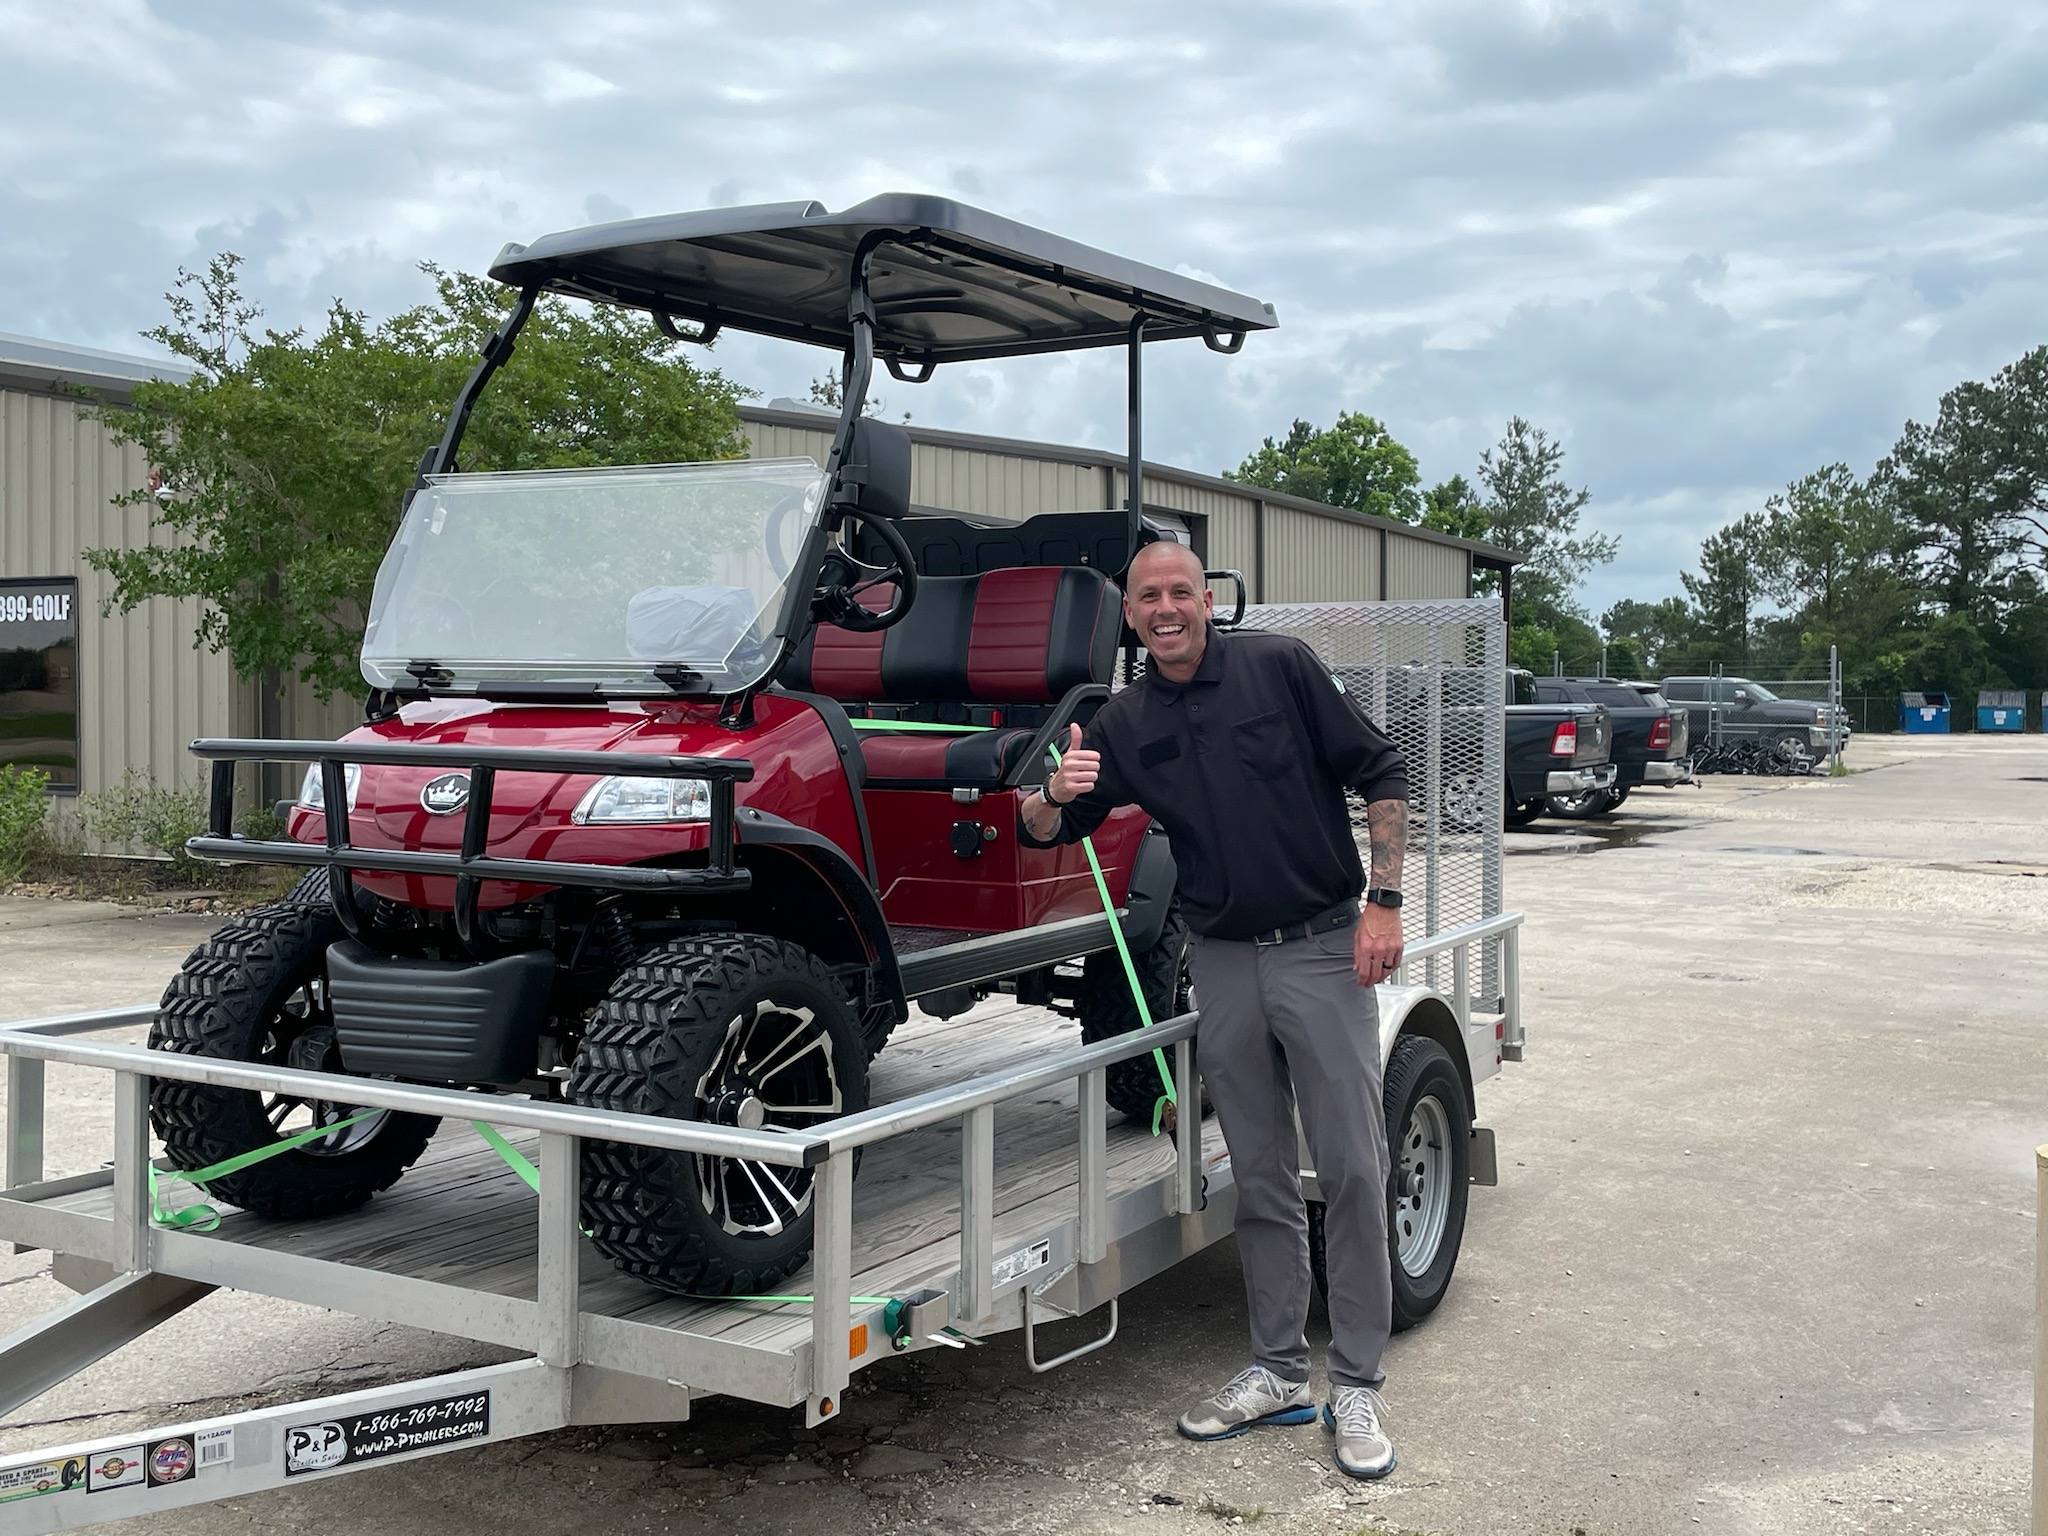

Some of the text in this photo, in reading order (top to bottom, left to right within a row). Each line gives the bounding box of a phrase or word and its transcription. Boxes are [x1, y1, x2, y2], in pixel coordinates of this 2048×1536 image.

[353, 1396, 486, 1436] 1-866-769-7992
[293, 1426, 341, 1457] P & P
